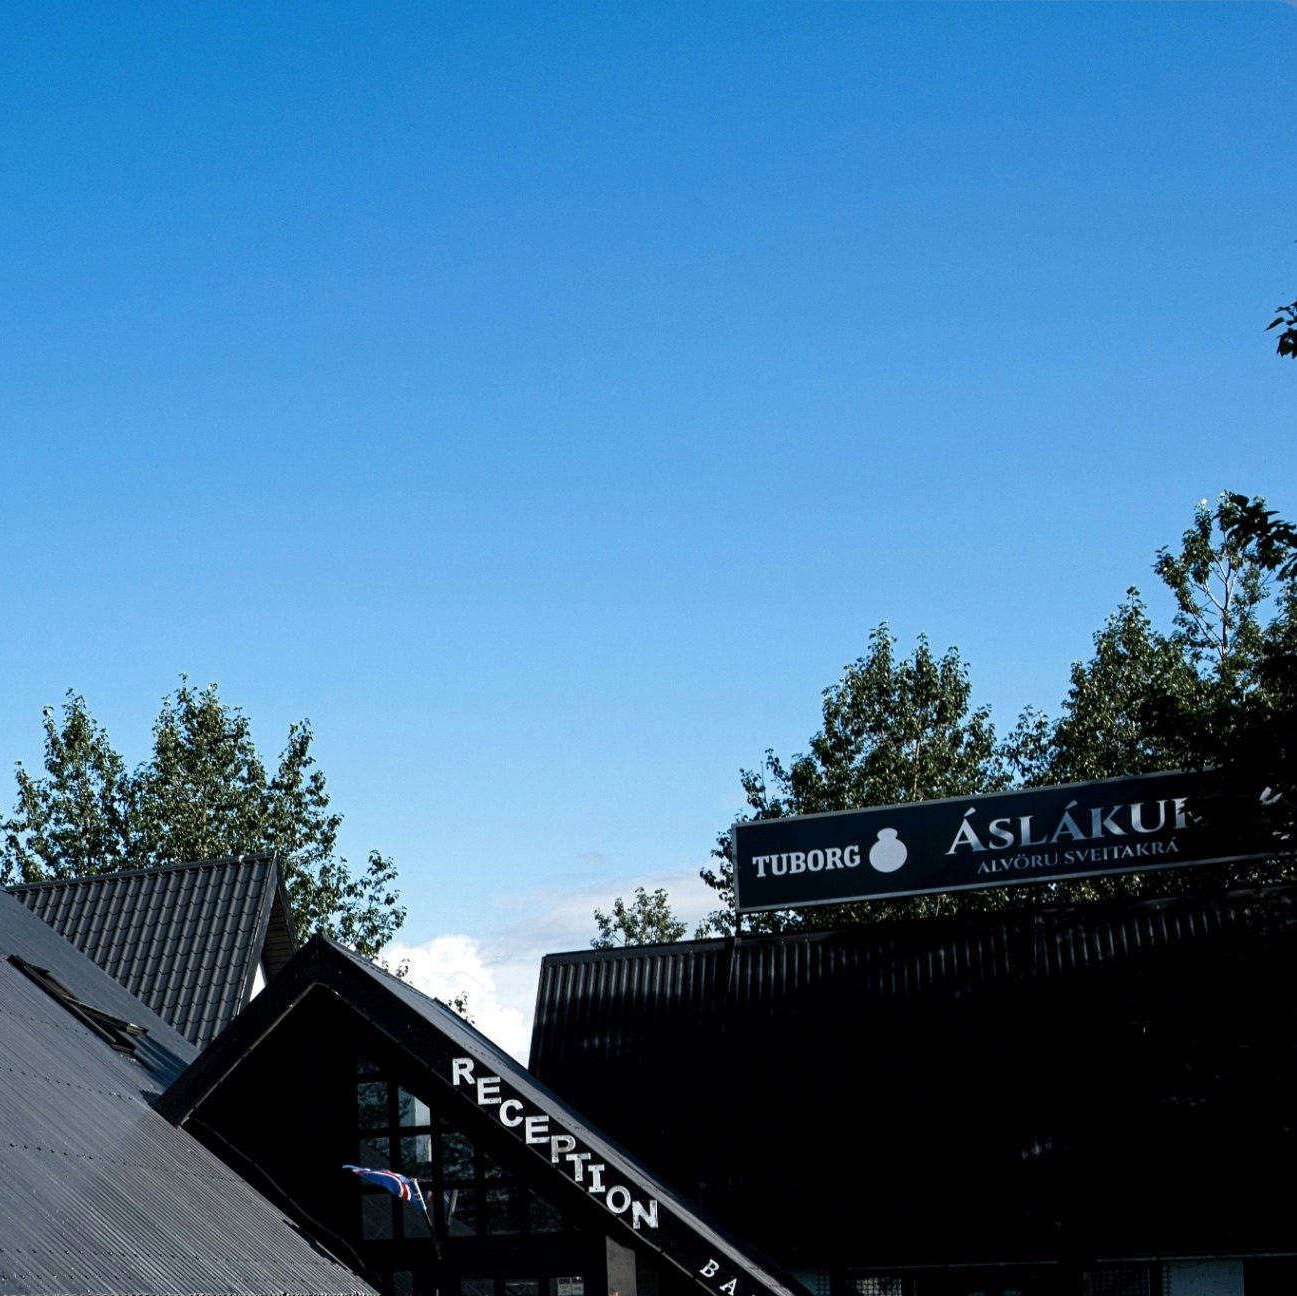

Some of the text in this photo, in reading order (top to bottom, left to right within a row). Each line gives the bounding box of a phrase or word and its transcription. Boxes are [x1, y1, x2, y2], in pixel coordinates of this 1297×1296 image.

[752, 845, 861, 878] TUBORG
[977, 837, 1180, 875] ALVÖRU SVEITAKRÁ
[451, 1057, 659, 1230] RECEPTION
